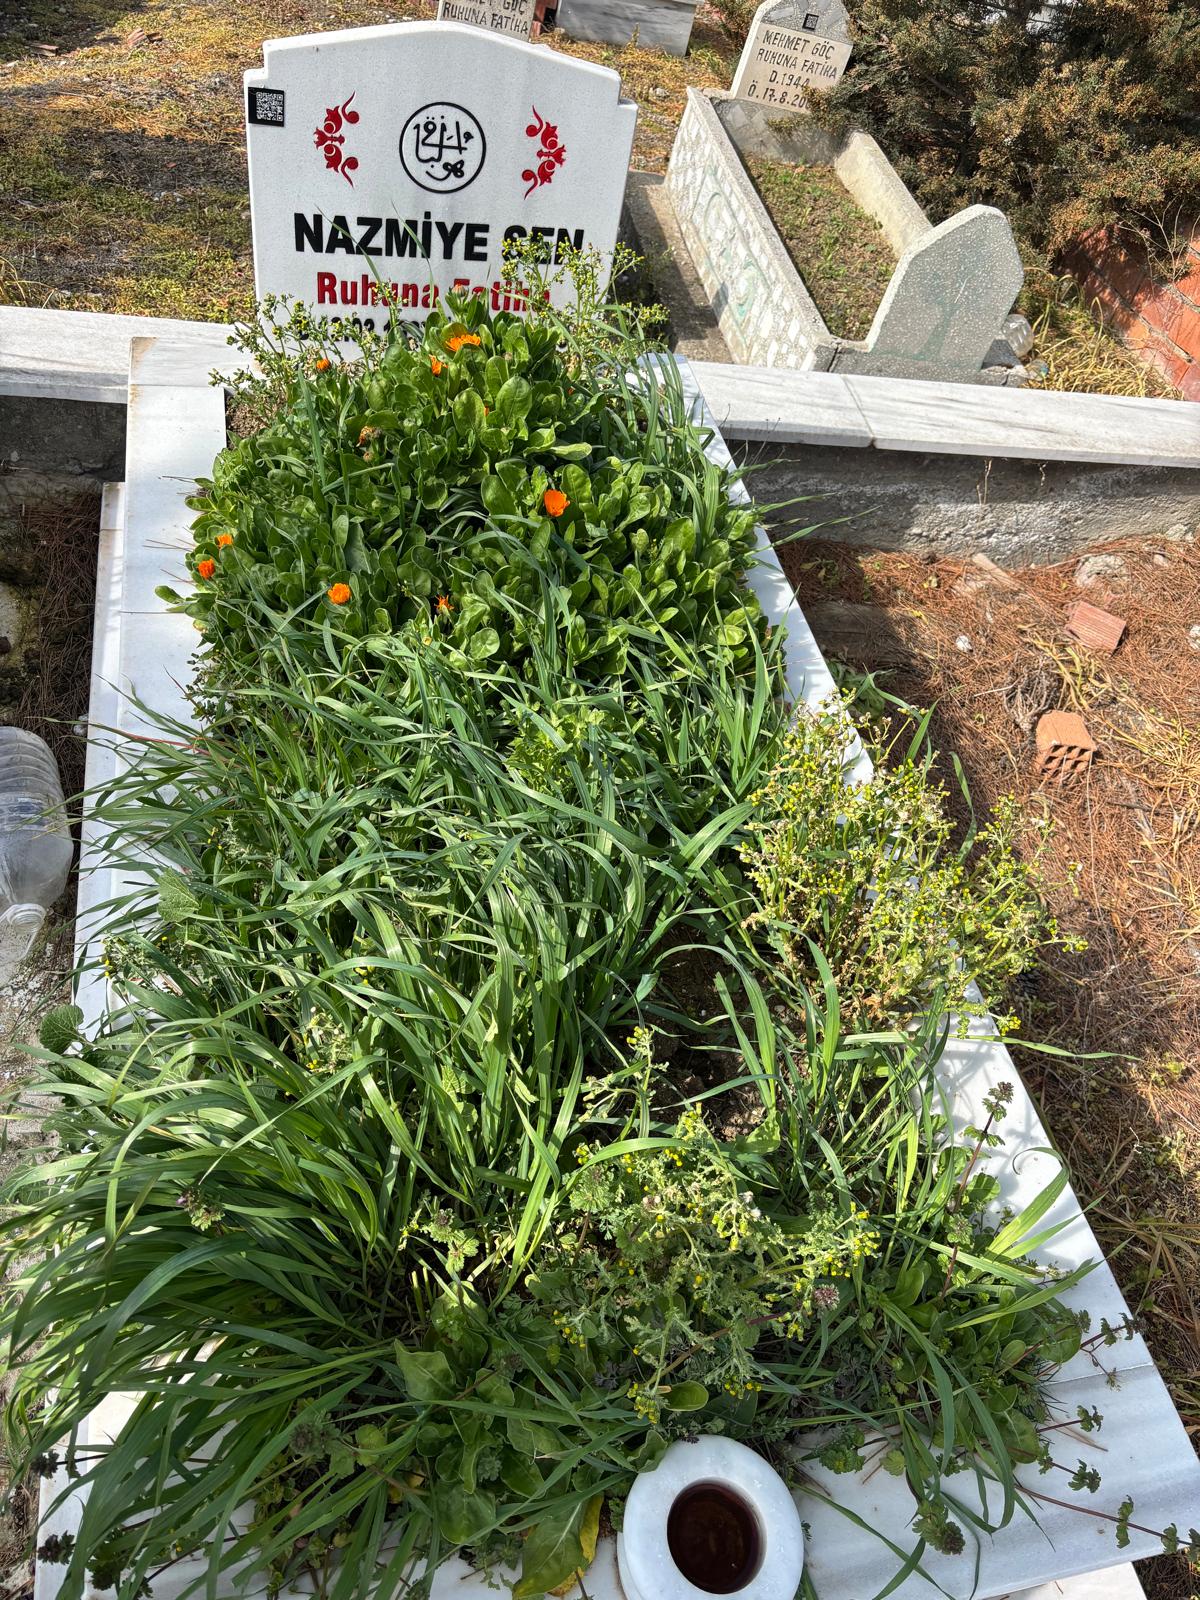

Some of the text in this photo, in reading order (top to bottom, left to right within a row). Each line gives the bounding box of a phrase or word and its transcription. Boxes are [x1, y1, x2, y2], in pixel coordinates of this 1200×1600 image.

[443, 2, 528, 35] RUHUNA FATİHA
[756, 48, 798, 71] RUHUNA
[762, 30, 835, 61] MEHMET GÖÇ
[294, 211, 490, 262] NAZMİYE
[316, 271, 440, 309] Ruhuna
